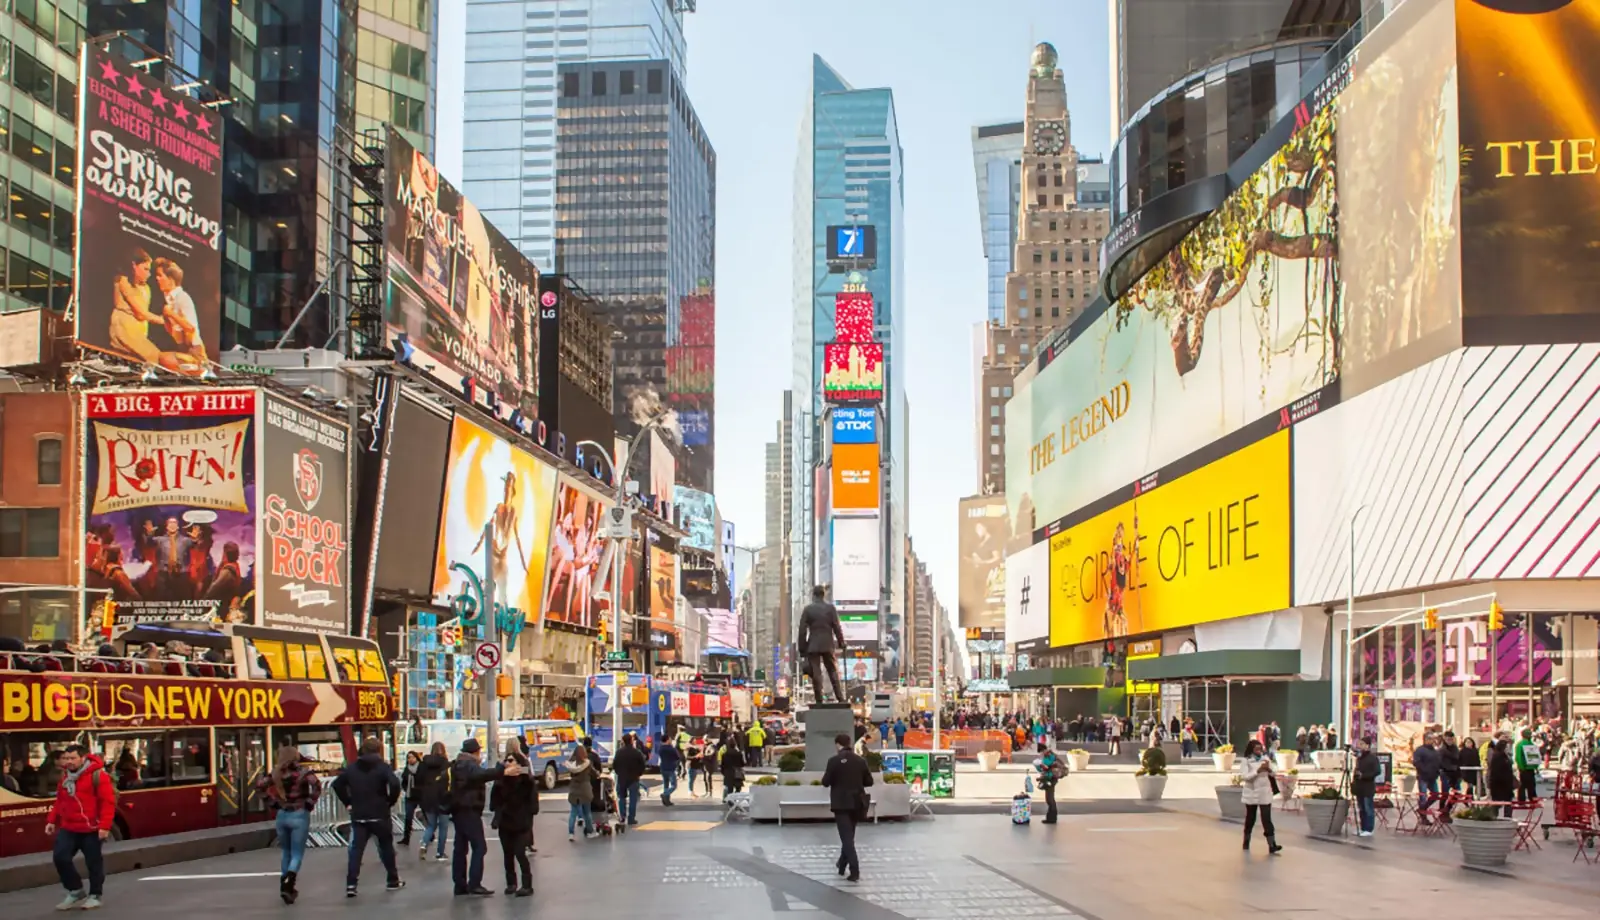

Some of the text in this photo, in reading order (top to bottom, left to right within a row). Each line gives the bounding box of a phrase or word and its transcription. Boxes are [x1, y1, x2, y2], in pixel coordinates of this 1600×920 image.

[1313, 49, 1360, 101] MARRIOTT
[1313, 70, 1354, 114] MARQUIS
[99, 100, 108, 121] A
[110, 105, 151, 142] SHEER
[90, 129, 193, 204] SPRING
[1485, 138, 1599, 178] THE
[86, 164, 222, 251] awakening
[397, 173, 473, 262] MARQUEE
[842, 230, 859, 253] 7
[842, 283, 866, 293] 2016
[542, 309, 556, 319] LG
[444, 332, 502, 384] VORNADO
[159, 395, 196, 411] FAT
[117, 429, 227, 446] SOMETHING
[845, 420, 872, 430] TDK
[1030, 379, 1131, 475] THE LEGEND
[100, 431, 243, 503] ROTTEN!
[264, 494, 346, 550] SCHOOL
[272, 535, 342, 587] ROCK
[1080, 533, 1147, 604] CIRLE
[1157, 518, 1195, 582] OF
[1208, 493, 1260, 571] LIFE
[181, 599, 221, 608] ALADDIN
[143, 685, 212, 720] NEW
[217, 687, 285, 720] YORK
[358, 690, 377, 705] BIG
